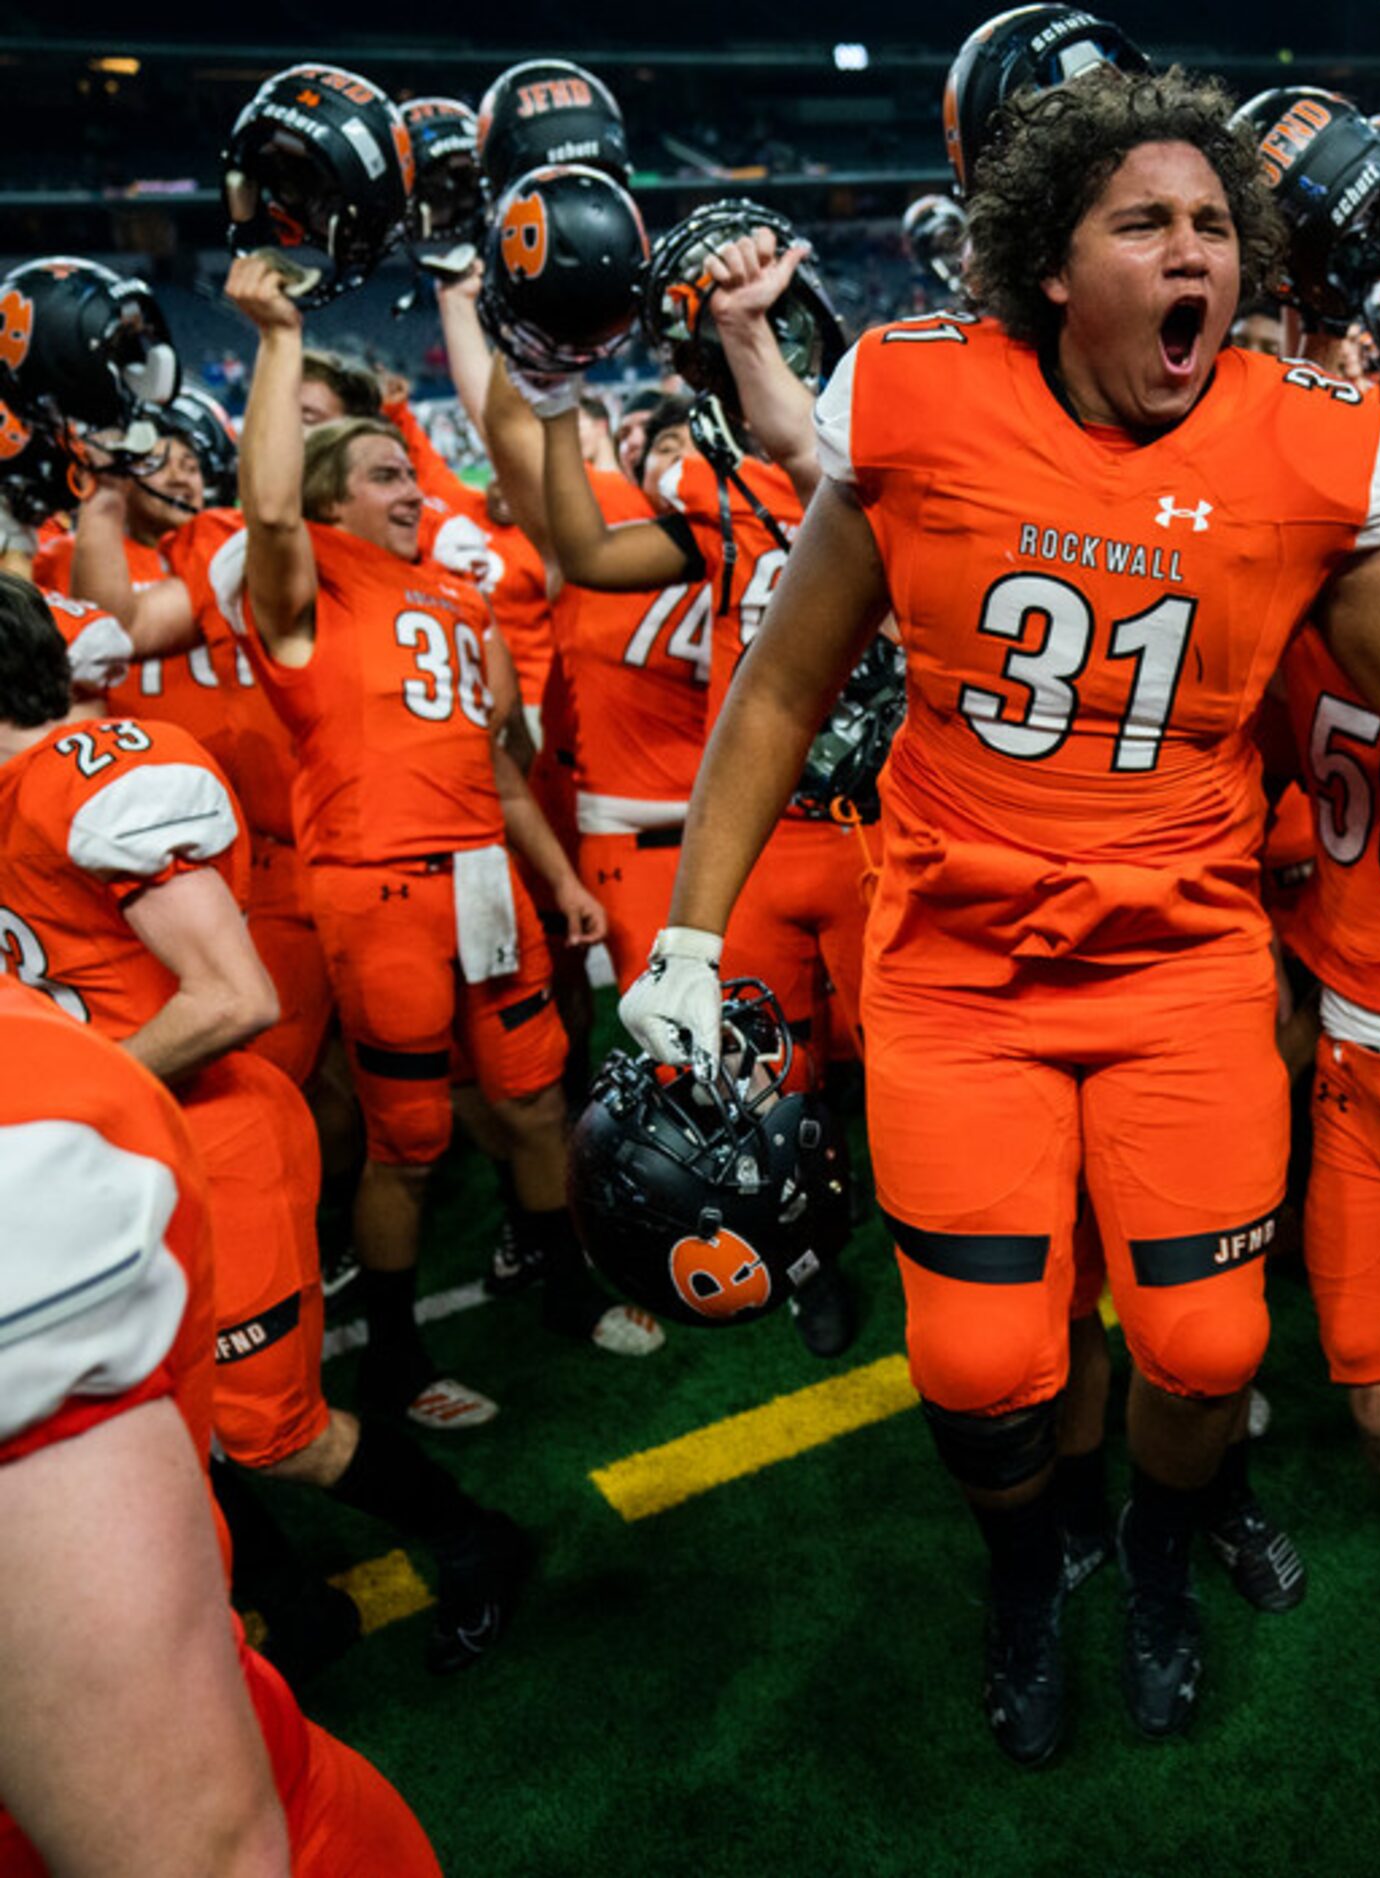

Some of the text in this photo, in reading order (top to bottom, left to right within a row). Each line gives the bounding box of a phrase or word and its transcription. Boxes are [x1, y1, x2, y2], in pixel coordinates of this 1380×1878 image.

[1019, 522, 1184, 583] ROCKWALL
[958, 571, 1199, 773] 31
[55, 720, 153, 779] 23
[215, 1322, 267, 1360] FND
